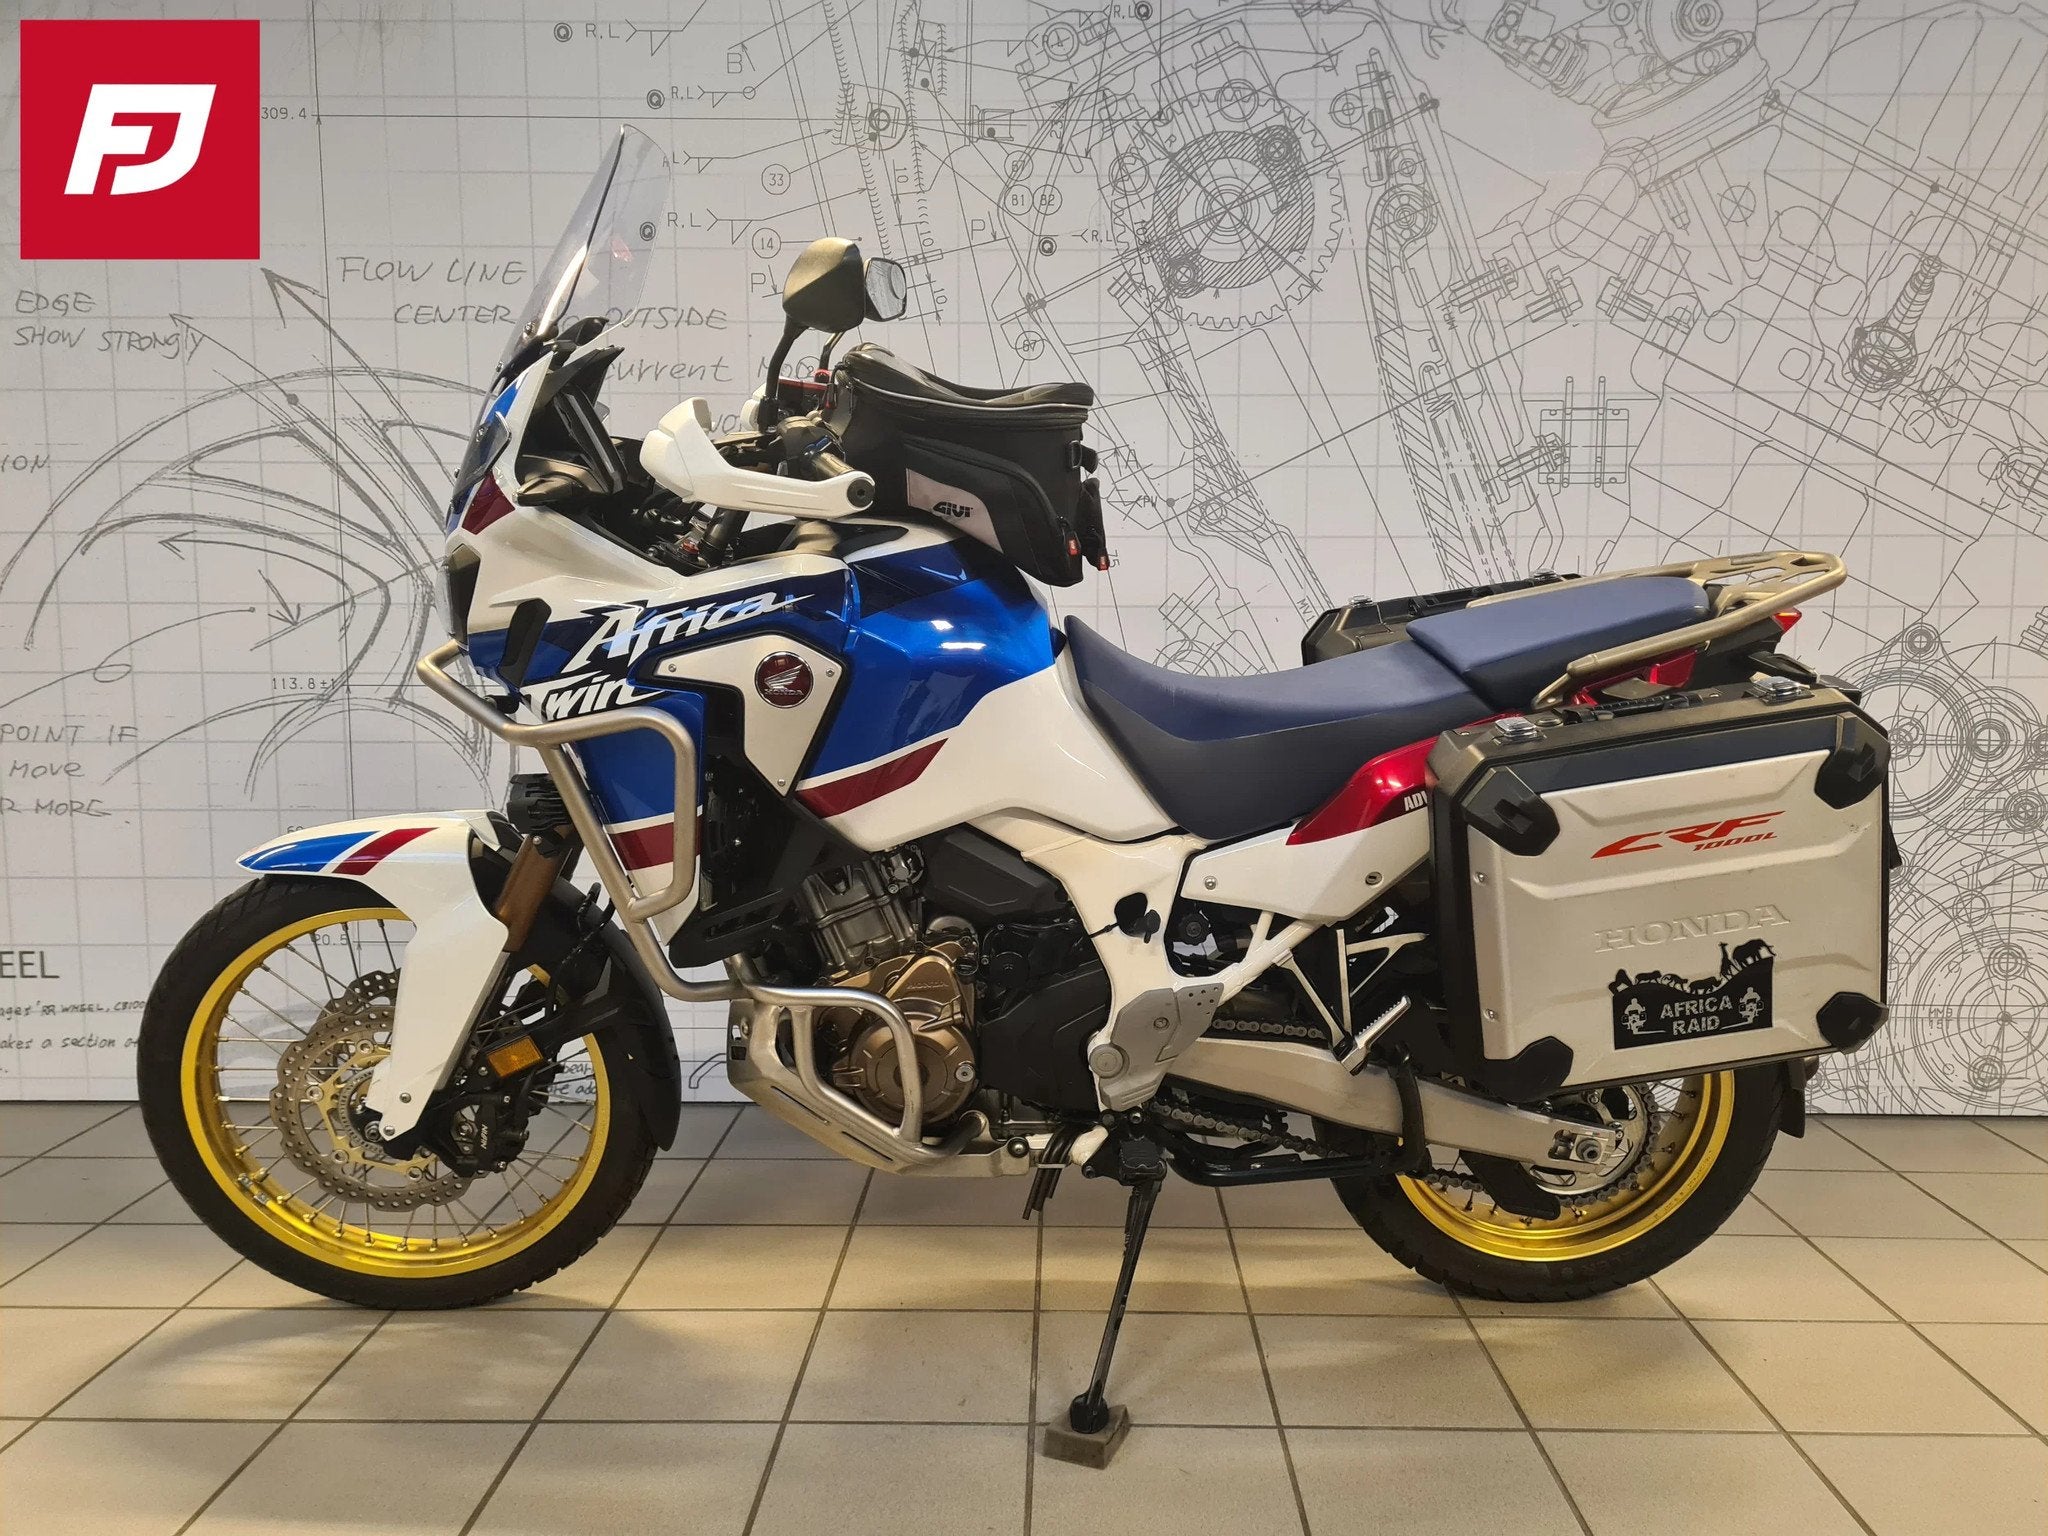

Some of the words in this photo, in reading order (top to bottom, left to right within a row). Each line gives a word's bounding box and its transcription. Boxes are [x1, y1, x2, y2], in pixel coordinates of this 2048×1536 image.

[727, 52, 743, 74] B
[261, 106, 307, 120] 309.4
[769, 173, 784, 187] 33
[1011, 193, 1025, 206] 81
[1040, 193, 1055, 206] 82
[971, 219, 986, 240] P
[761, 237, 774, 251] 14
[337, 256, 433, 283] FLOW
[447, 258, 527, 286] LINE
[15, 290, 97, 317] EDGE
[394, 303, 516, 325] CENTER
[604, 306, 728, 330] OUTSIDE
[13, 326, 86, 348] SHOW
[932, 501, 971, 518] GIVI
[561, 592, 815, 674] Africa
[520, 669, 667, 724] Twin
[0, 723, 86, 746] POINT
[108, 724, 138, 747] IF
[1590, 810, 1787, 860] CRF
[1692, 831, 1778, 852] 1000L
[1594, 904, 1791, 953] HONDA
[0, 950, 60, 979] EEL
[1660, 995, 1734, 1020] AFRICA
[1672, 1015, 1721, 1036] RAID
[61, 1033, 117, 1049] section
